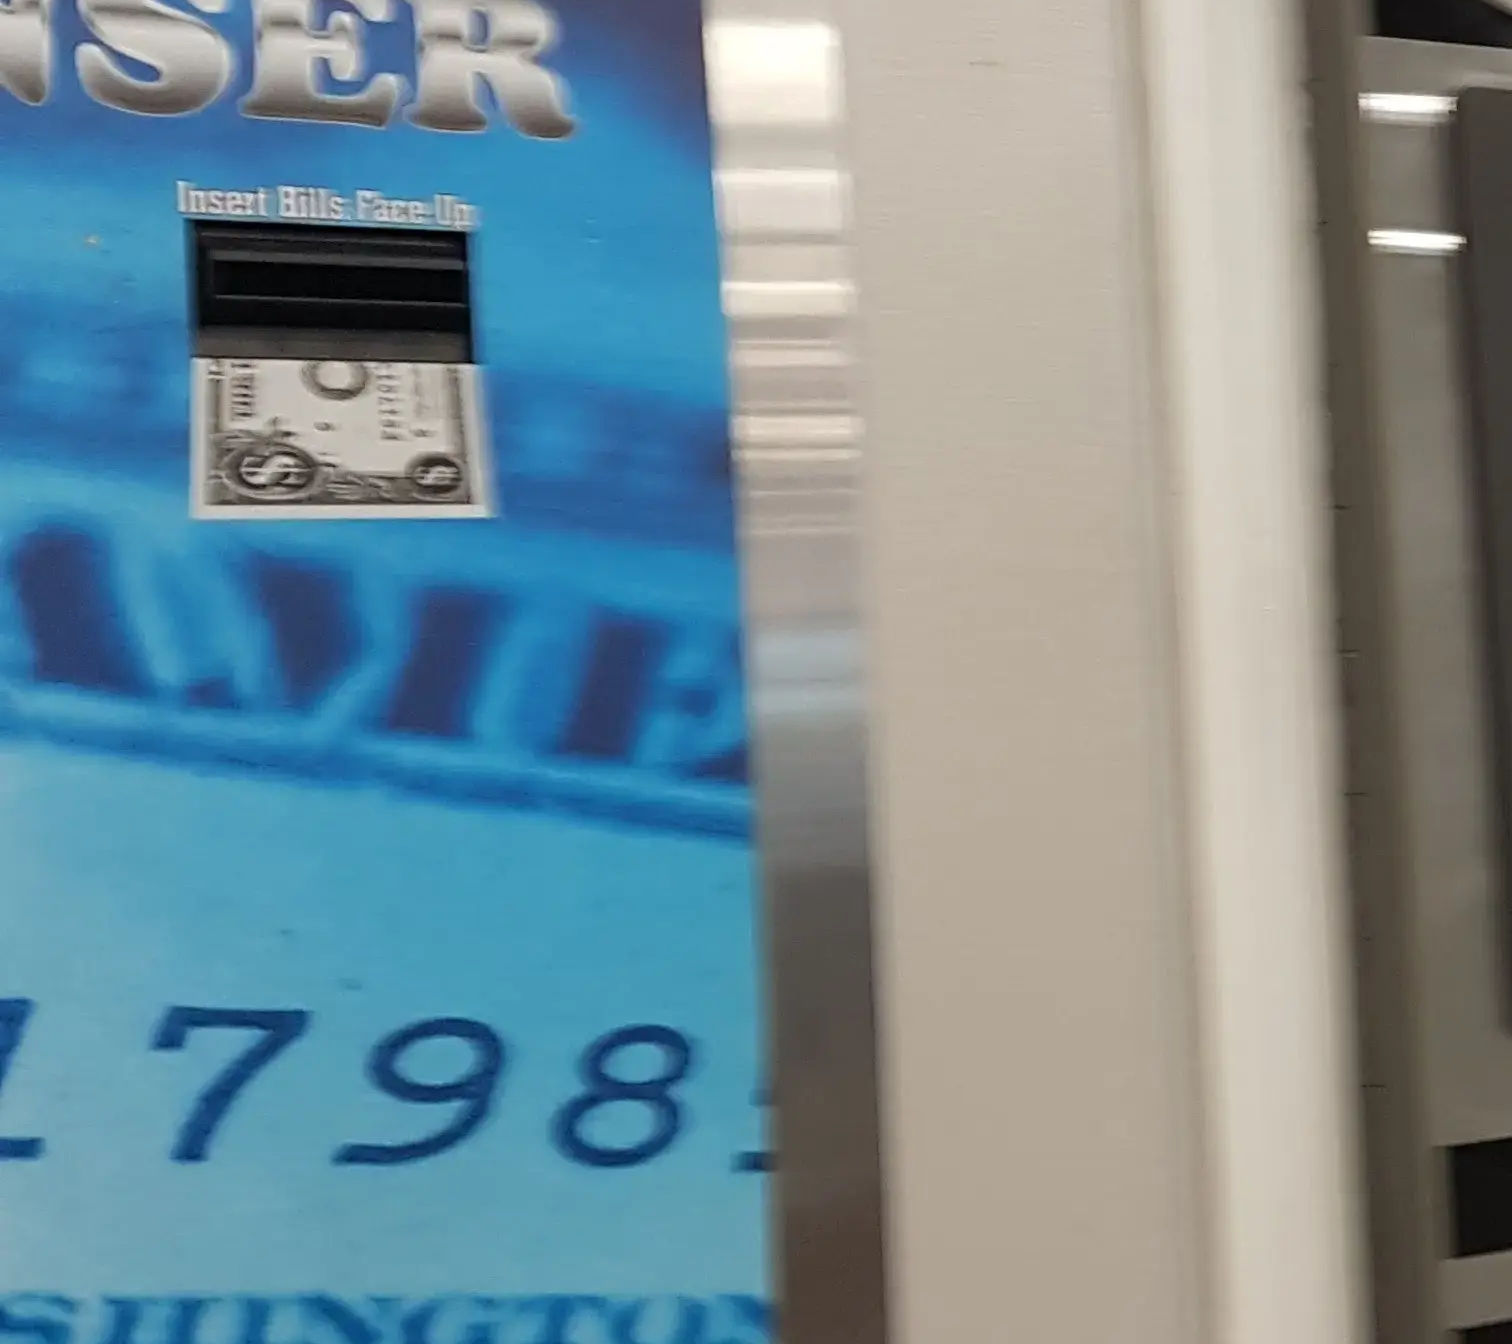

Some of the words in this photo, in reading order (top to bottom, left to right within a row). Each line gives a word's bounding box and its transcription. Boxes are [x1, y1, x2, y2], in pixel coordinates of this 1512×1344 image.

[176, 179, 270, 217] Insert
[276, 184, 346, 220] Bills
[356, 189, 428, 226] Face
[430, 193, 480, 230] Up
